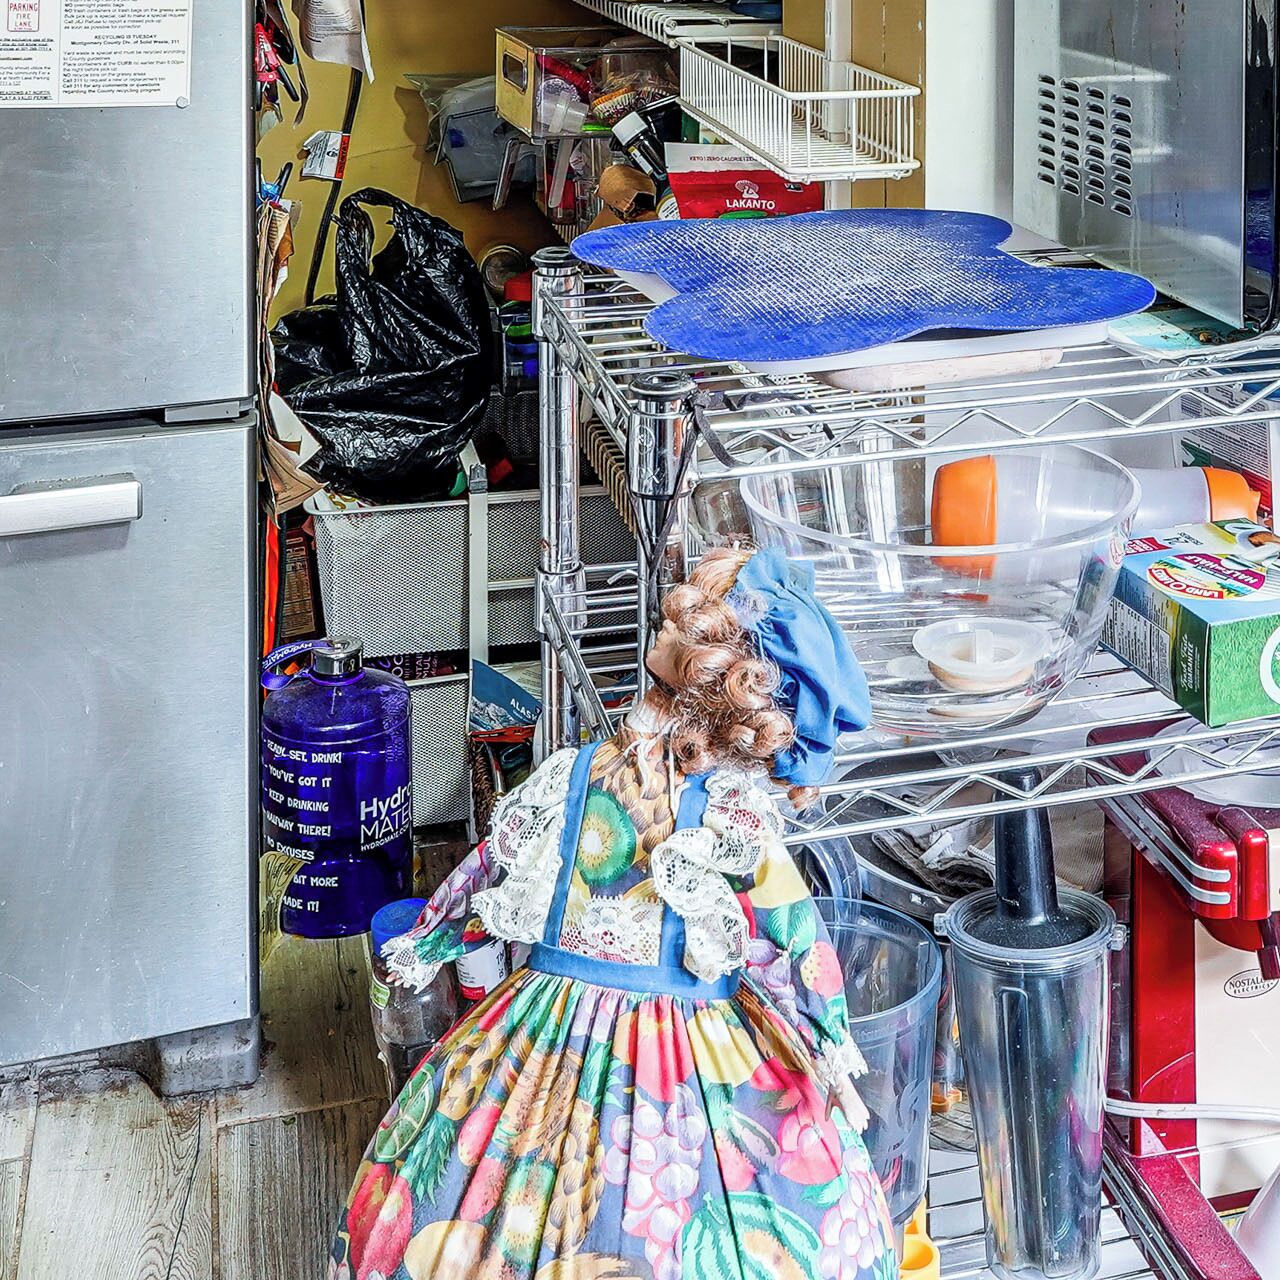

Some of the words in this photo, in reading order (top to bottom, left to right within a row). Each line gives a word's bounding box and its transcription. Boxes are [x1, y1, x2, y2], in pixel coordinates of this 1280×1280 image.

[10, 3, 38, 12] PARKING
[726, 199, 775, 210] LAKANTO
[311, 751, 342, 764] DRINK!
[298, 774, 318, 787] GOT
[321, 776, 332, 788] IT
[287, 794, 329, 812] DRINKING
[298, 822, 332, 837] THERE!
[310, 876, 338, 887] MORE
[306, 898, 320, 912] IT!
